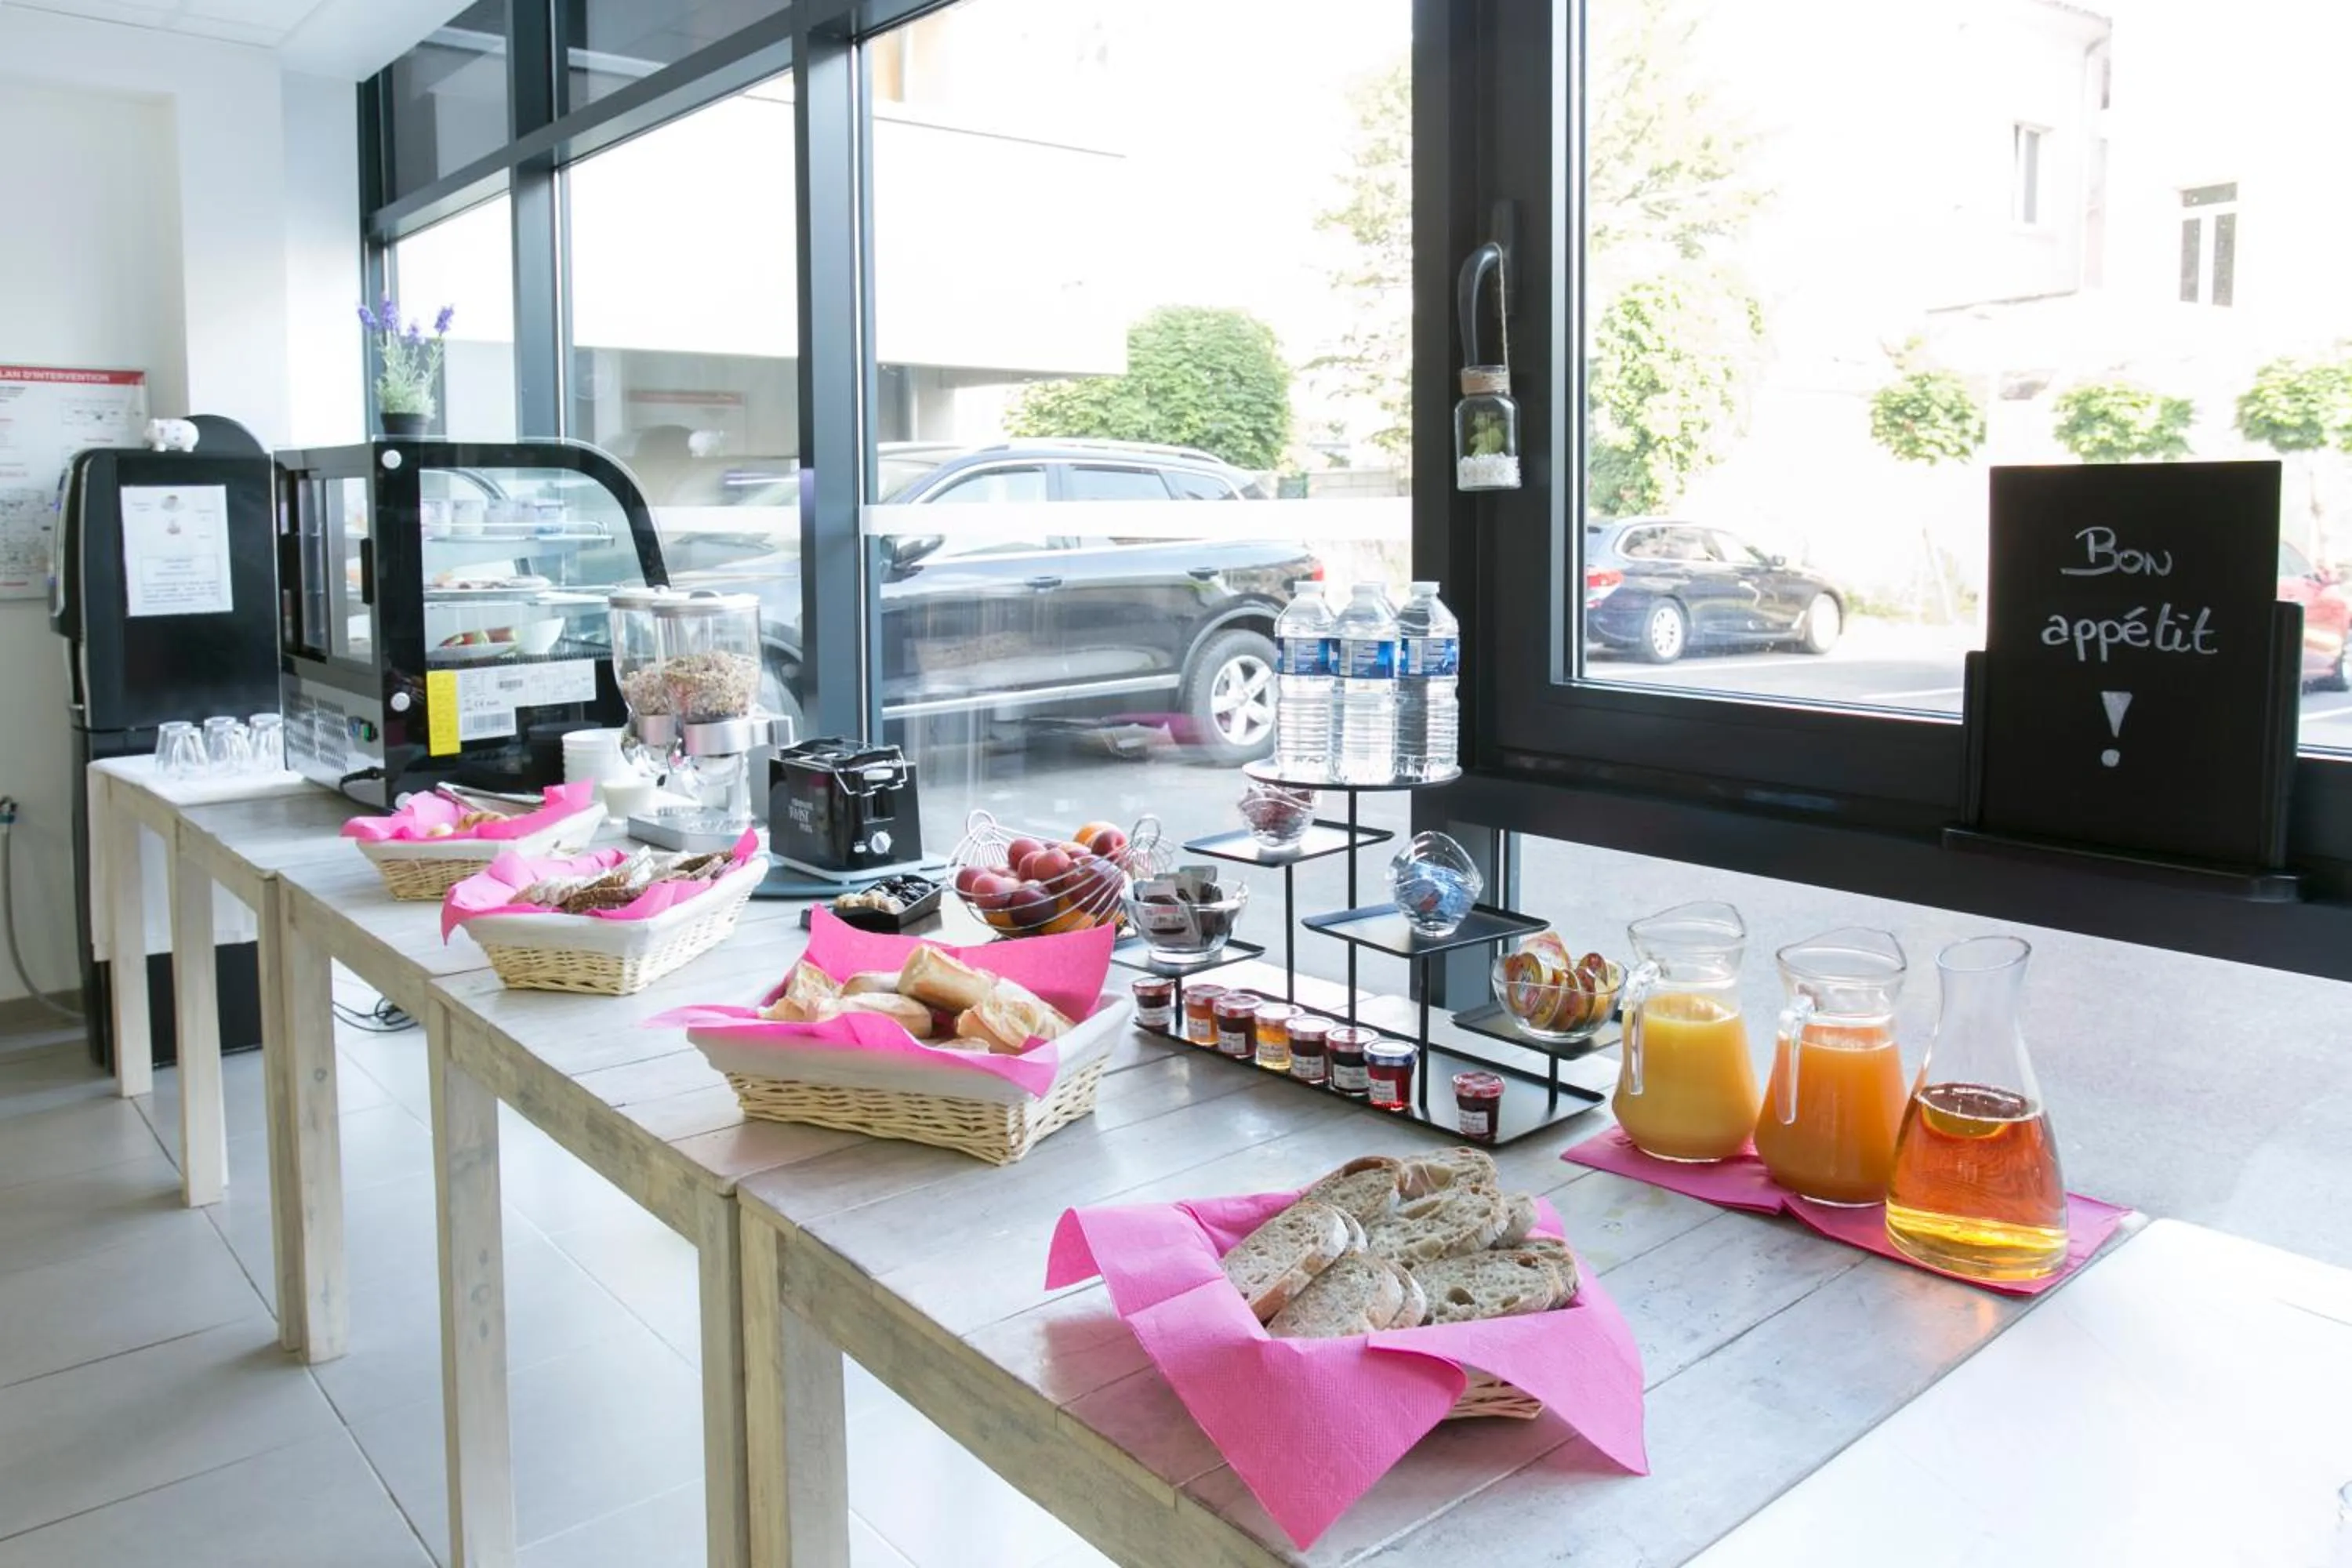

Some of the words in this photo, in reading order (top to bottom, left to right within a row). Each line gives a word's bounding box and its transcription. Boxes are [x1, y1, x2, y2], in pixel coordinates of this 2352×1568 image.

[24, 372, 110, 382] D'INTERVENTION
[2042, 603, 2218, 662] appétit
[2101, 691, 2132, 767] !
